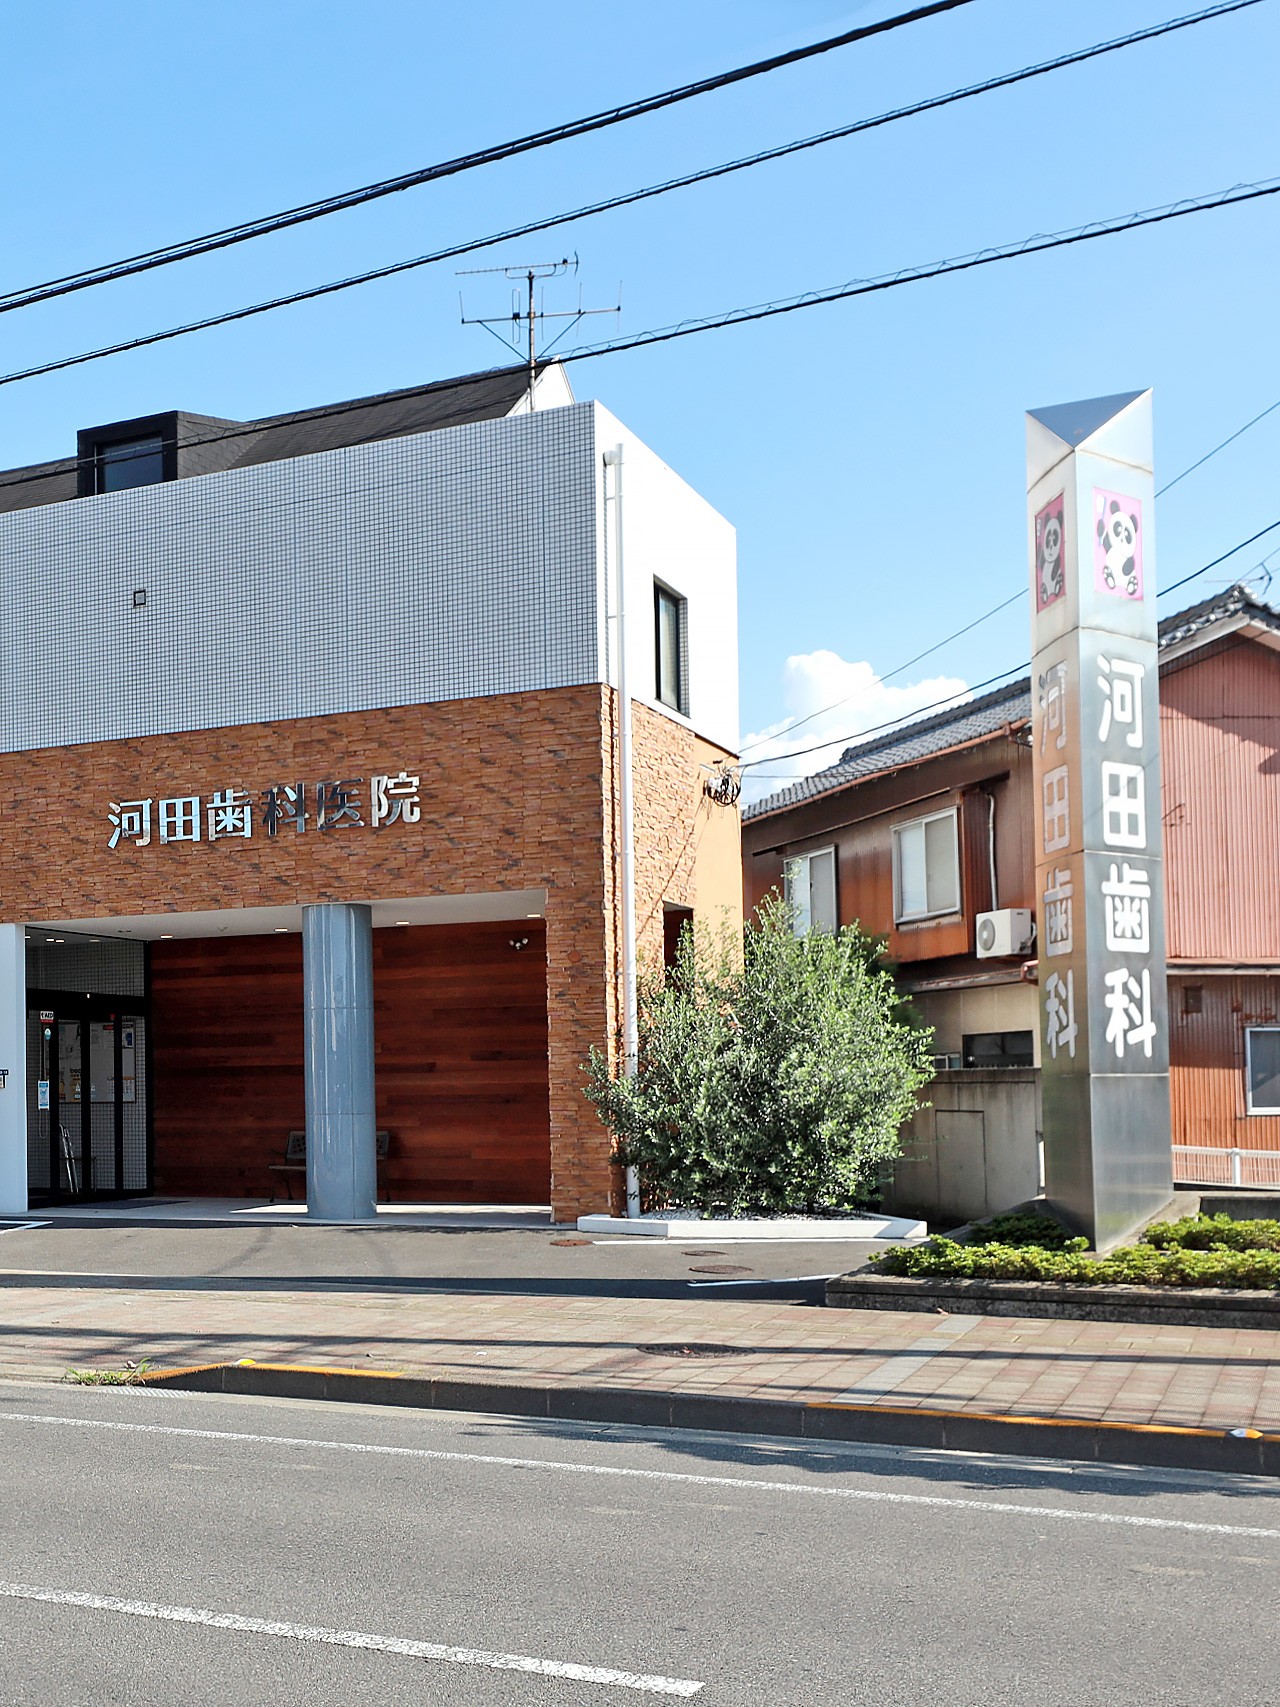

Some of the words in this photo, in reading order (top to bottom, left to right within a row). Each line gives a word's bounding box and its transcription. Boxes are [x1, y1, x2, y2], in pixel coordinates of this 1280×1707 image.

[106, 771, 421, 849] 河田歯科医院
[1039, 660, 1078, 1060] 河田歯科
[1096, 653, 1157, 1059] 河田歯科
